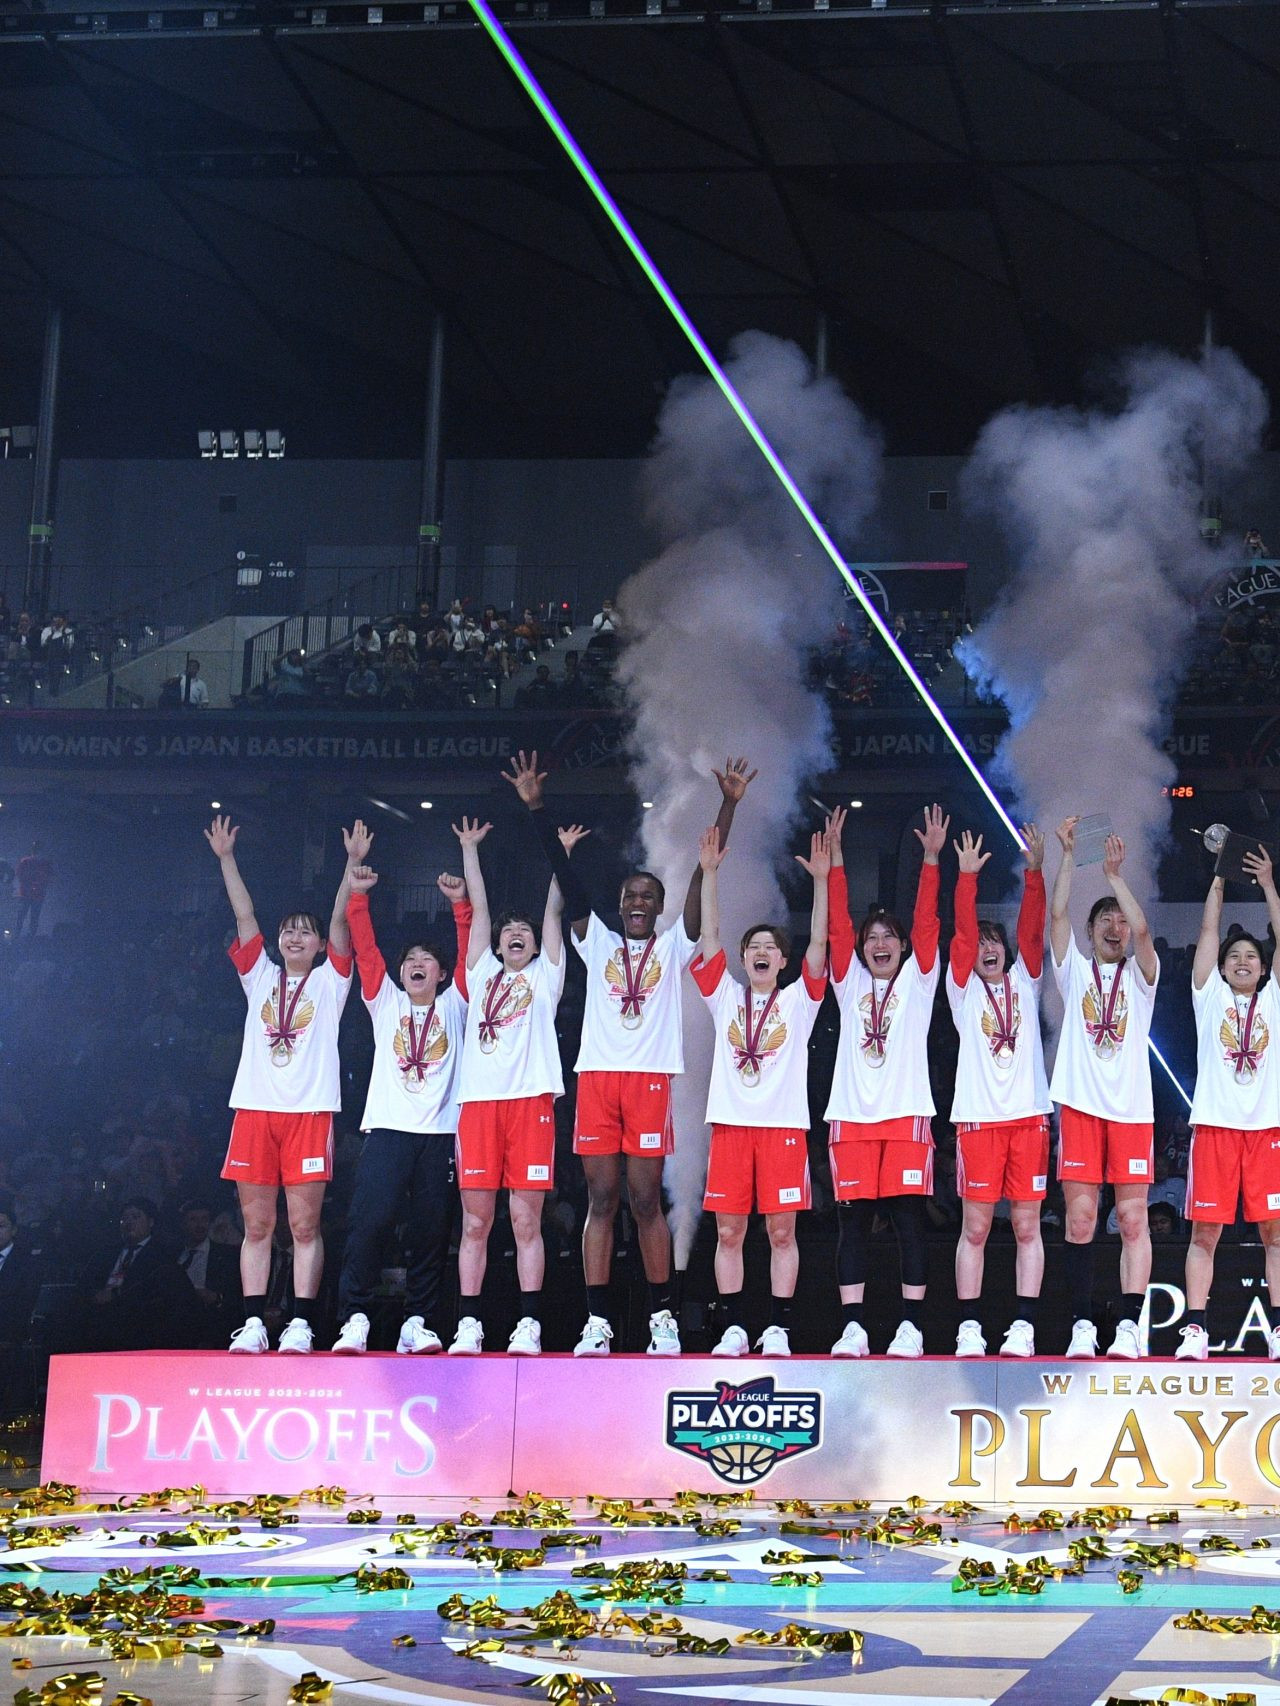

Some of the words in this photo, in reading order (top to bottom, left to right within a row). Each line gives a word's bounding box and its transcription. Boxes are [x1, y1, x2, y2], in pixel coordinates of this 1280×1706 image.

[16, 734, 149, 758] WOMEN'S
[154, 735, 239, 757] JAPAN
[246, 735, 405, 759] BASKETBALL
[413, 735, 512, 758] LEAGUE
[850, 733, 936, 757] JAPAN
[188, 1387, 201, 1397] W
[206, 1388, 262, 1397] LEAGUE
[268, 1388, 343, 1398] 2023-2024
[1042, 1375, 1073, 1395] W
[1088, 1375, 1234, 1396] LEAGUE
[737, 1393, 770, 1402] LEAGUE
[672, 1404, 816, 1429] PLAYOFFS
[89, 1393, 439, 1477] PLAYOFFS
[714, 1432, 772, 1444] 2023-2024
